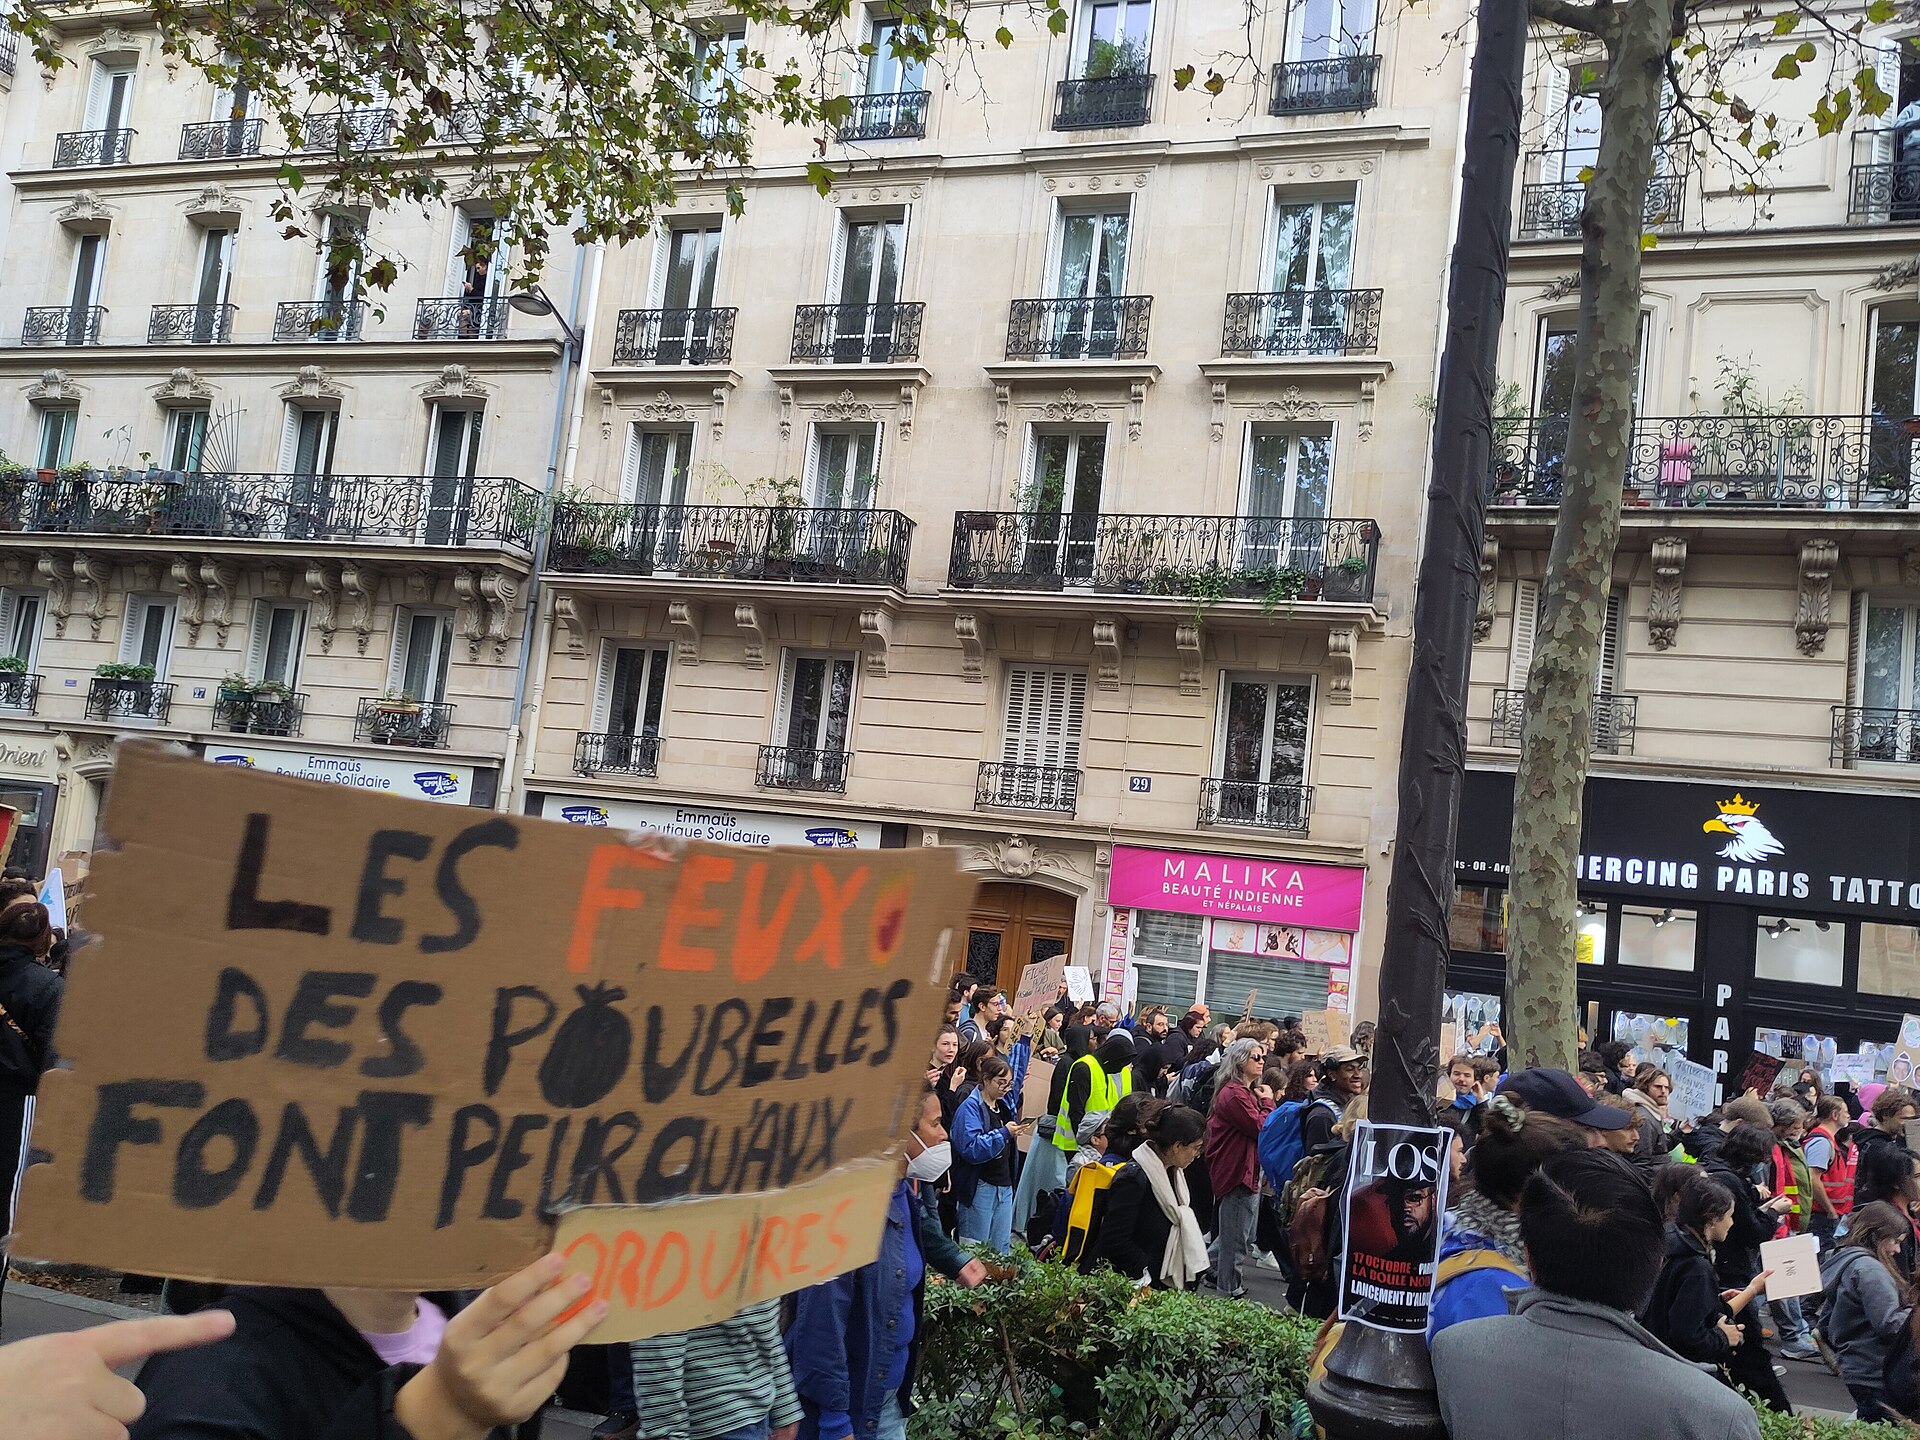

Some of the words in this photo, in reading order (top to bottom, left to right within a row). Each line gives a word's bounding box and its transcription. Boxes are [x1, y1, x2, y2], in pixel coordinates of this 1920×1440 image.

[193, 688, 205, 698] 27
[308, 755, 361, 772] Emmaüs
[335, 772, 391, 789] Solidaire
[1132, 778, 1149, 791] 29
[676, 809, 737, 827] Emmaüs
[707, 826, 771, 845] Solidaire
[1163, 858, 1305, 891] MALIKA
[1473, 861, 1486, 871] OR
[226, 813, 521, 954] LES
[565, 844, 871, 983] FEUX
[1162, 882, 1221, 899] BEAUTÉ
[1228, 889, 1304, 907] INDIENNE
[1716, 865, 1810, 899] PARIS
[1829, 875, 1920, 910] TATTO
[1202, 900, 1214, 908] ET
[1217, 900, 1263, 913] NÉPALAIS
[204, 967, 444, 1079] DES
[483, 978, 914, 1109] POUBELLES
[79, 1079, 438, 1224] FONT
[436, 1103, 643, 1230] PEUR
[1363, 1140, 1440, 1183] LOS
[550, 1198, 854, 1324] ORDURES
[1353, 1252, 1364, 1265] 17
[1365, 1256, 1411, 1274] OCTOBRE
[1352, 1263, 1367, 1278] LA
[1370, 1268, 1406, 1287] BOULE
[1351, 1280, 1404, 1307] LANCEMENT
